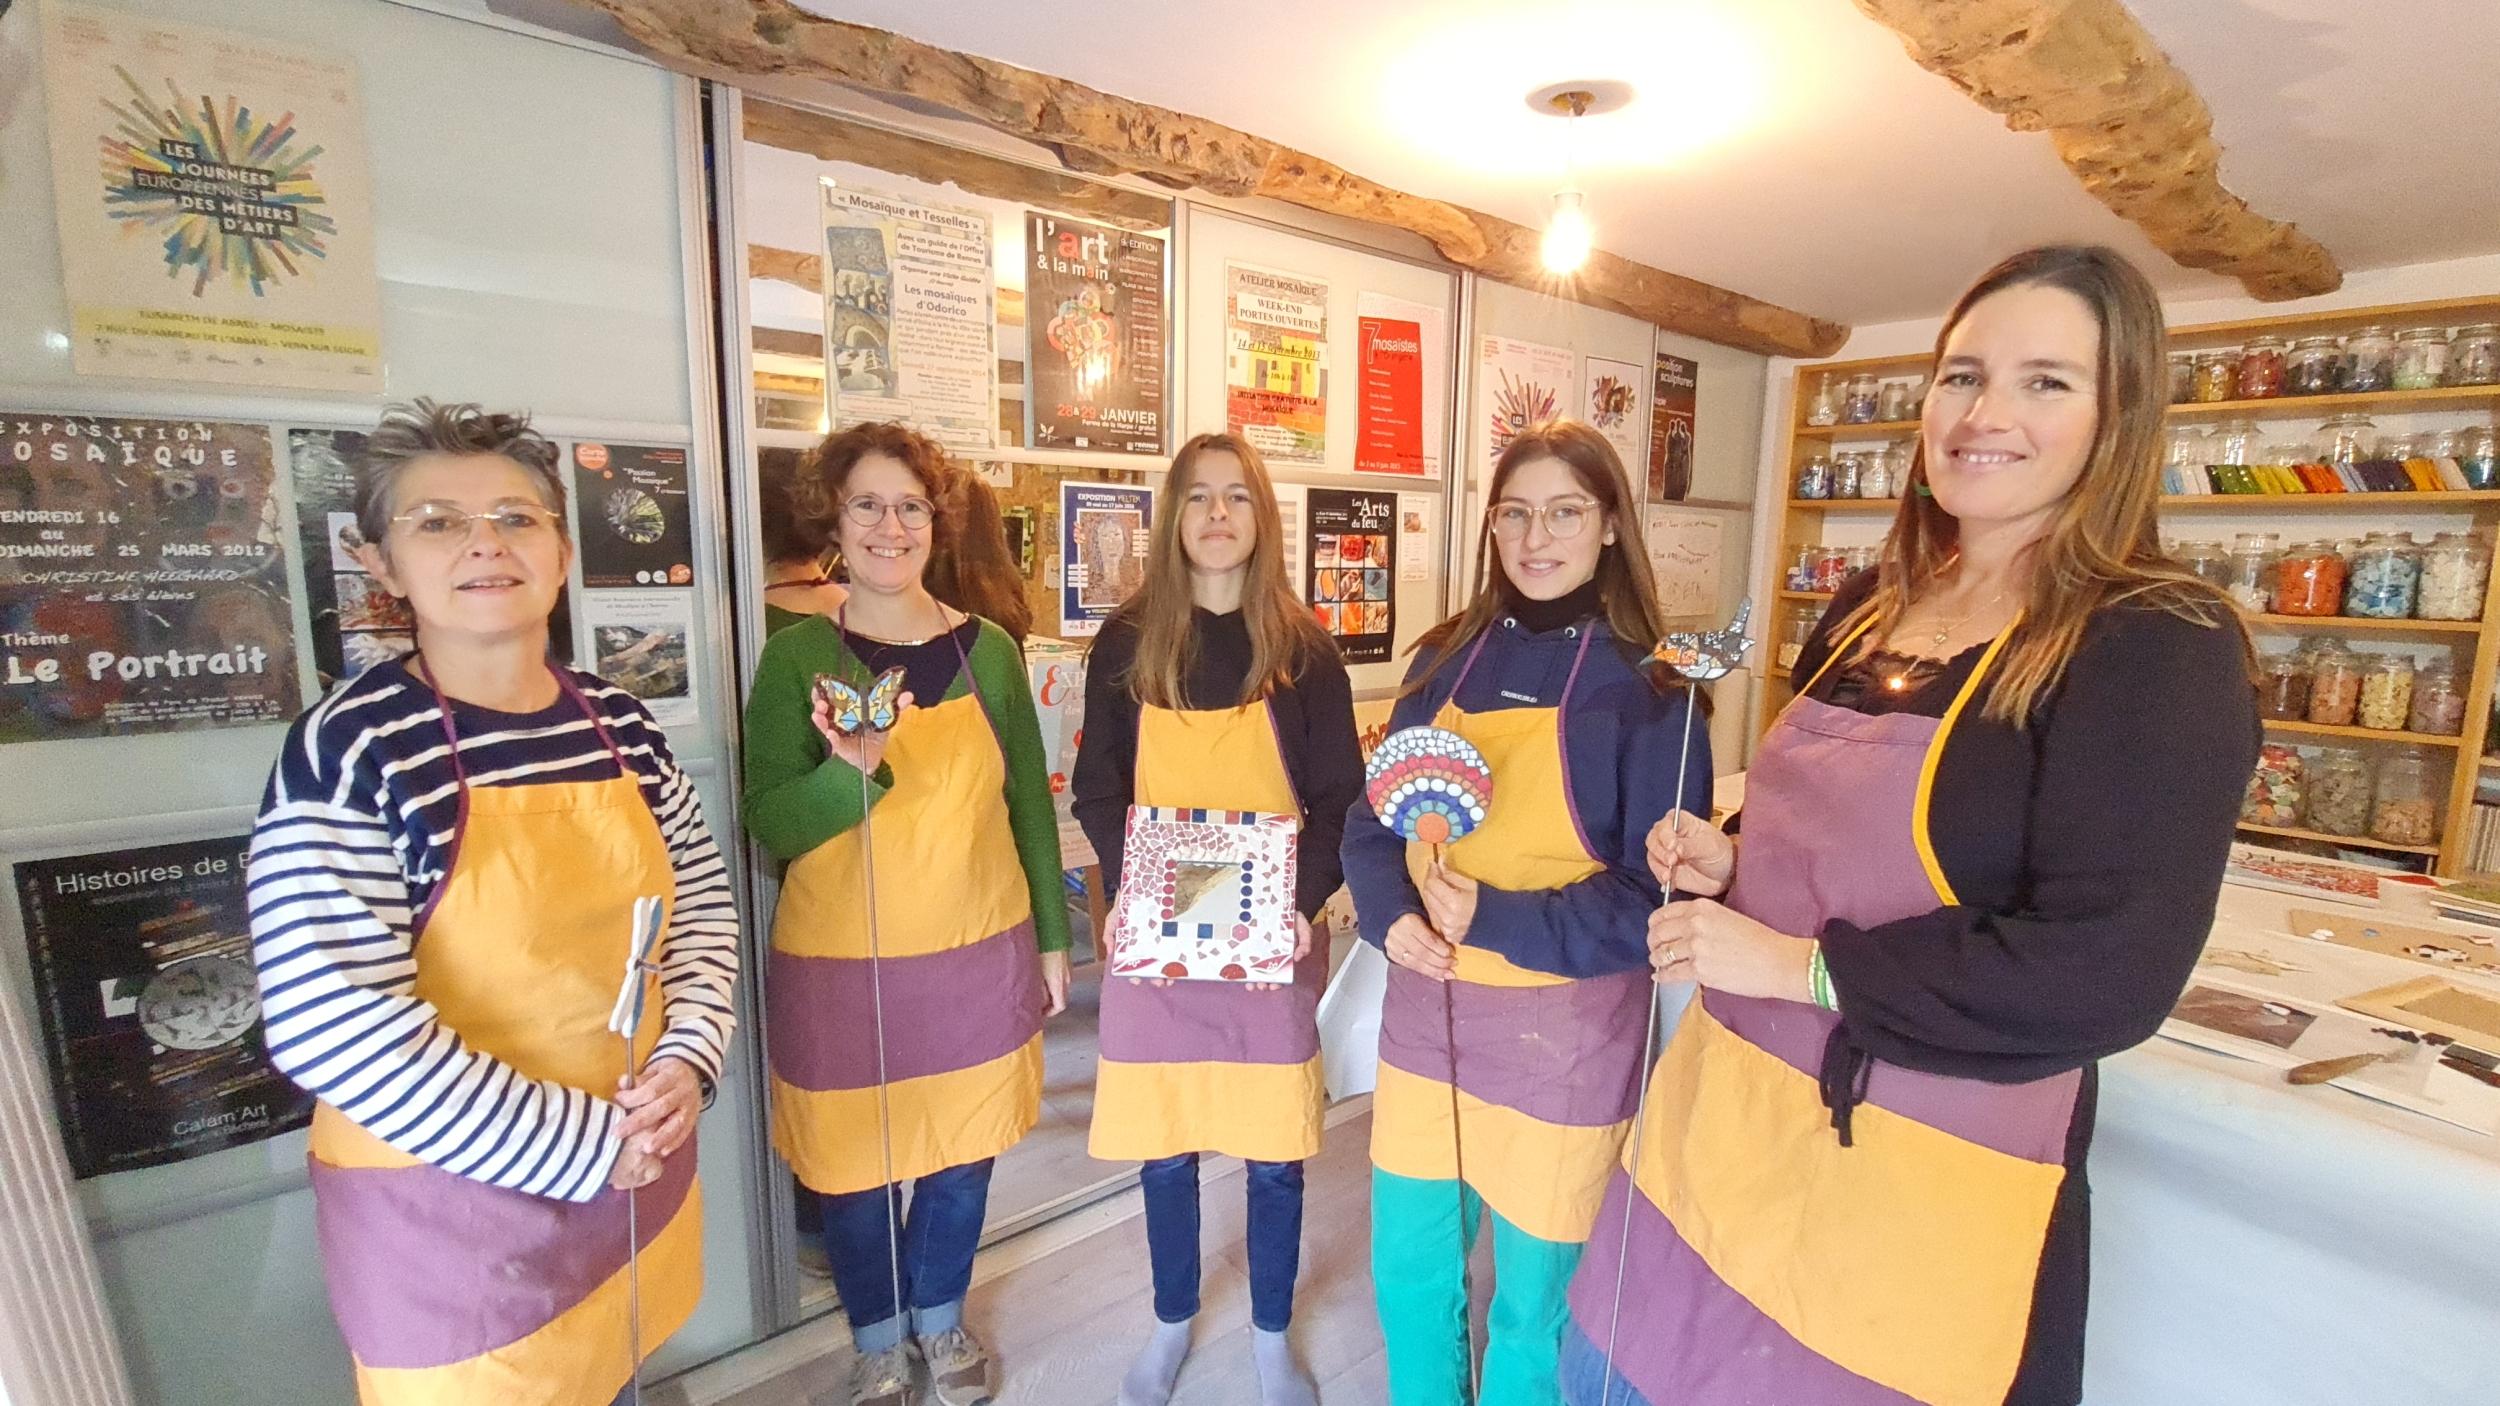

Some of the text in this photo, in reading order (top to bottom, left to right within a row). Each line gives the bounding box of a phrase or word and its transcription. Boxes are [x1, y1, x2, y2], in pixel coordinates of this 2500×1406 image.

[165, 143, 195, 159] LES
[177, 162, 270, 186] JOURNÉES
[138, 173, 258, 200] EUROPÉENNES
[181, 196, 293, 222] DES MÉTIERS
[849, 194, 906, 216] Mosaïque
[908, 209, 920, 220] et
[923, 209, 970, 230] Tesselles
[223, 217, 275, 236] D'ART
[897, 231, 915, 243] Avec
[916, 235, 927, 244] un
[928, 236, 948, 248] guide
[948, 241, 958, 250] de
[1035, 217, 1109, 265] l'art
[901, 242, 911, 251] de
[946, 250, 956, 259] de
[1037, 254, 1110, 281] & la main
[1239, 273, 1275, 289] ATELIER
[904, 283, 978, 306] Les mosaïques
[916, 299, 967, 317] d'Odorico
[1257, 297, 1304, 315] WEEK-END
[1240, 308, 1319, 330] PORTES OUVERTES
[1362, 320, 1382, 365] 7
[1373, 338, 1418, 353] mosaïstes
[1057, 403, 1074, 417] 28
[1081, 405, 1097, 419] 29
[1100, 407, 1157, 425] JANVIER
[1077, 493, 1116, 503] EXPOSITION
[1351, 498, 1361, 507] Les
[1358, 497, 1390, 518] Arts
[97, 511, 120, 525] 16
[1351, 518, 1360, 528] du
[1361, 515, 1378, 529] feu
[40, 529, 65, 541] au
[118, 545, 141, 557] 25
[162, 543, 212, 557] MARS
[223, 544, 266, 557] 2012
[1, 631, 71, 647] Thème
[5, 645, 268, 685] Le Portrait
[55, 864, 184, 895] Histoires
[194, 856, 228, 876] de
